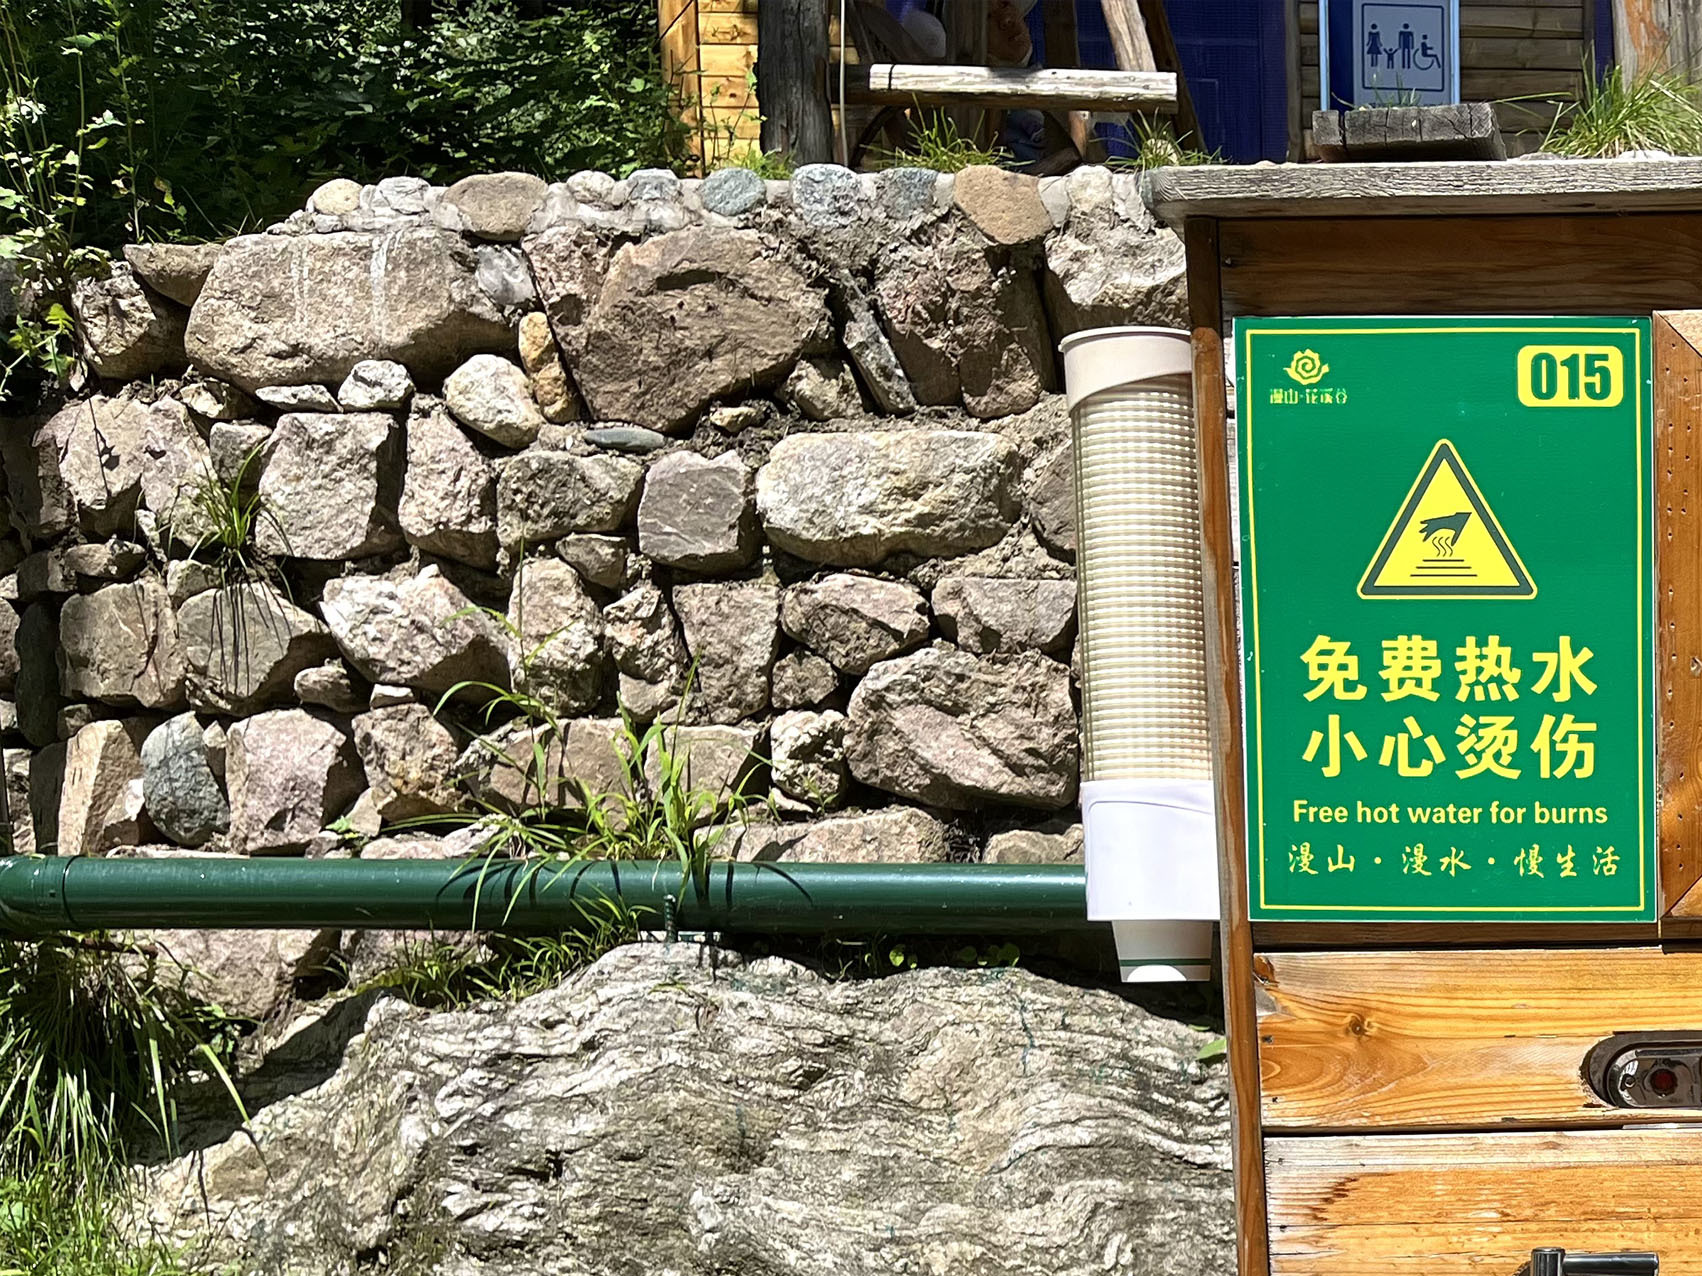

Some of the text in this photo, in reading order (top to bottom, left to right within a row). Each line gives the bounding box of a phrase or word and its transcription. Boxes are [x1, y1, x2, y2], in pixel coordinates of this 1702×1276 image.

[1530, 352, 1612, 401] 015
[1300, 634, 1598, 703] 免费热水
[1302, 713, 1597, 780] 小心烫伤
[1293, 799, 1608, 824] Free hot water for burns
